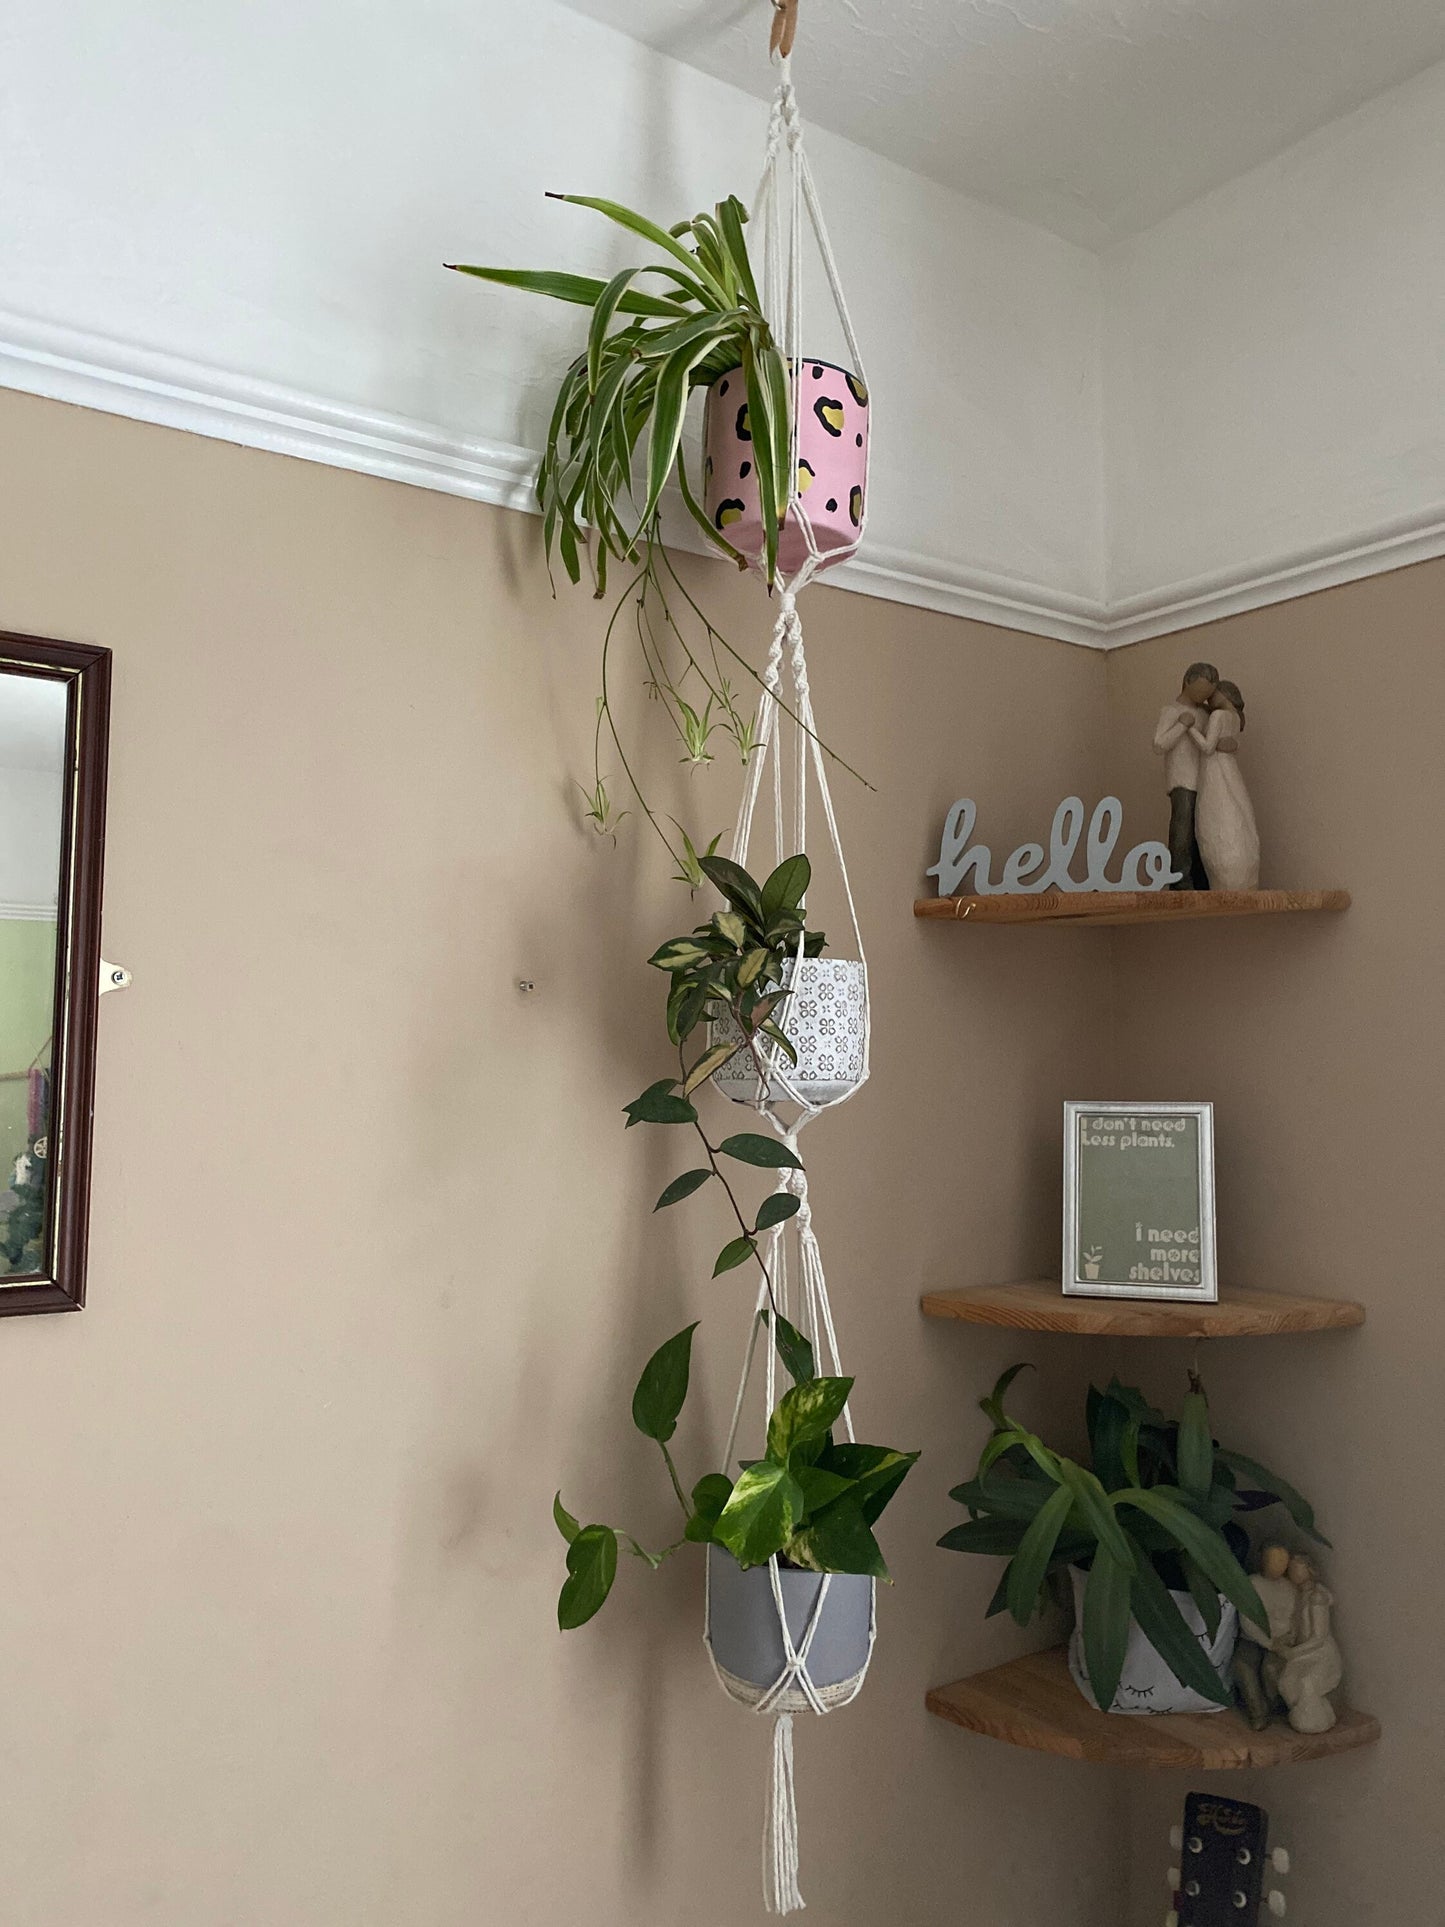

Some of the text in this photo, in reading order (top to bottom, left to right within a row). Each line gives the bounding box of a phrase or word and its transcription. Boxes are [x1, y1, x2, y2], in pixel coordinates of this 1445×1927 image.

[926, 796, 1183, 897] hello
[1092, 1117, 1136, 1131] don't
[1141, 1118, 1186, 1132] need
[1120, 1131, 1175, 1150] plants.
[1135, 1221, 1199, 1244] i need
[1150, 1248, 1199, 1263] more
